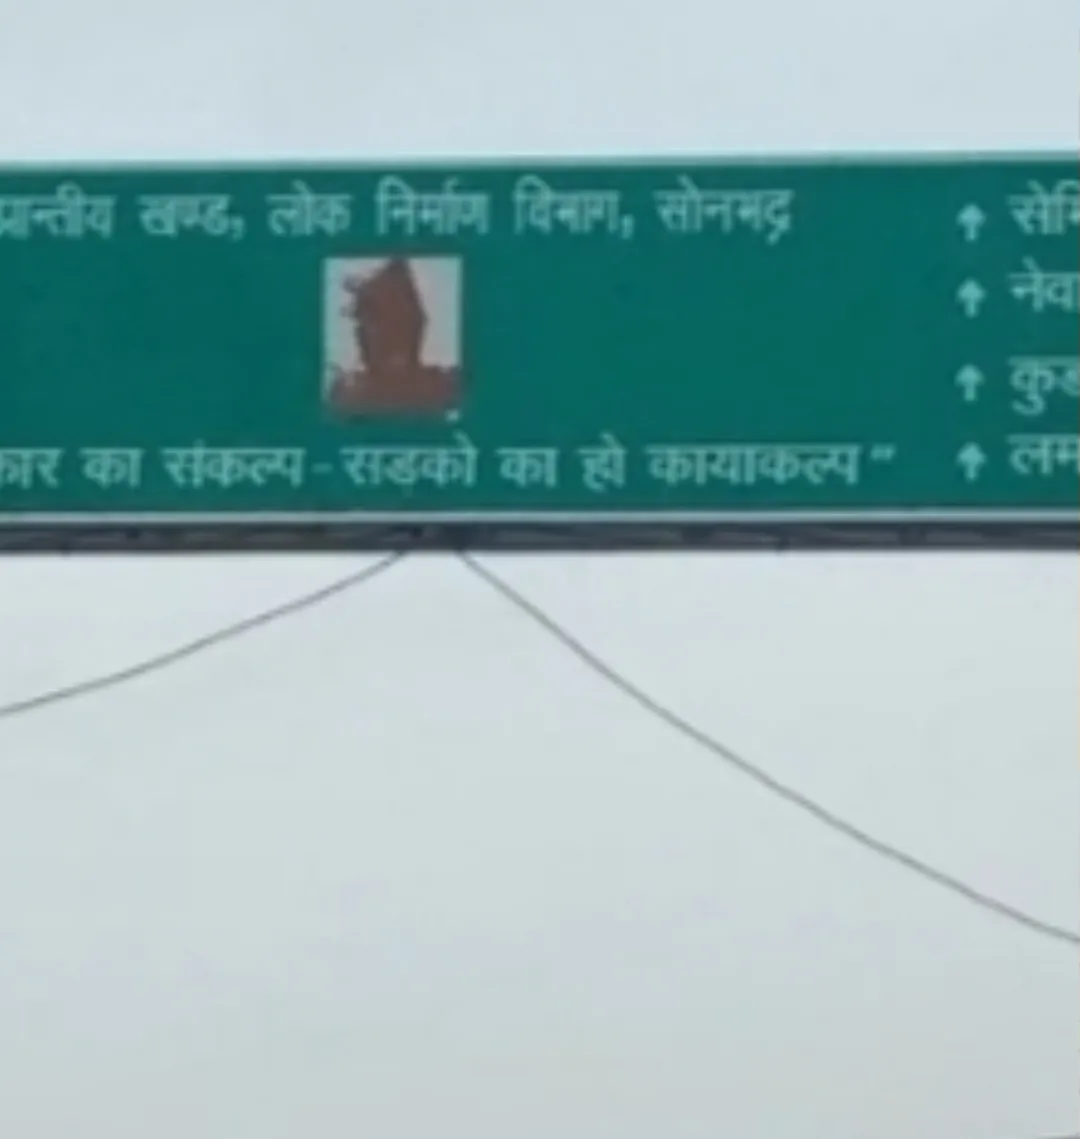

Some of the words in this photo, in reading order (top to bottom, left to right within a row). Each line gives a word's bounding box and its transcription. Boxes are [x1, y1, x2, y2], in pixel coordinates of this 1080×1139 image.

[265, 180, 352, 236] लोक
[375, 175, 491, 236] निर्माण
[512, 174, 635, 240] विभाग,
[653, 174, 795, 245] सोनभद्र
[78, 448, 143, 489] का
[160, 439, 305, 488] संकल्प
[496, 446, 558, 488] का
[578, 430, 627, 493] हो
